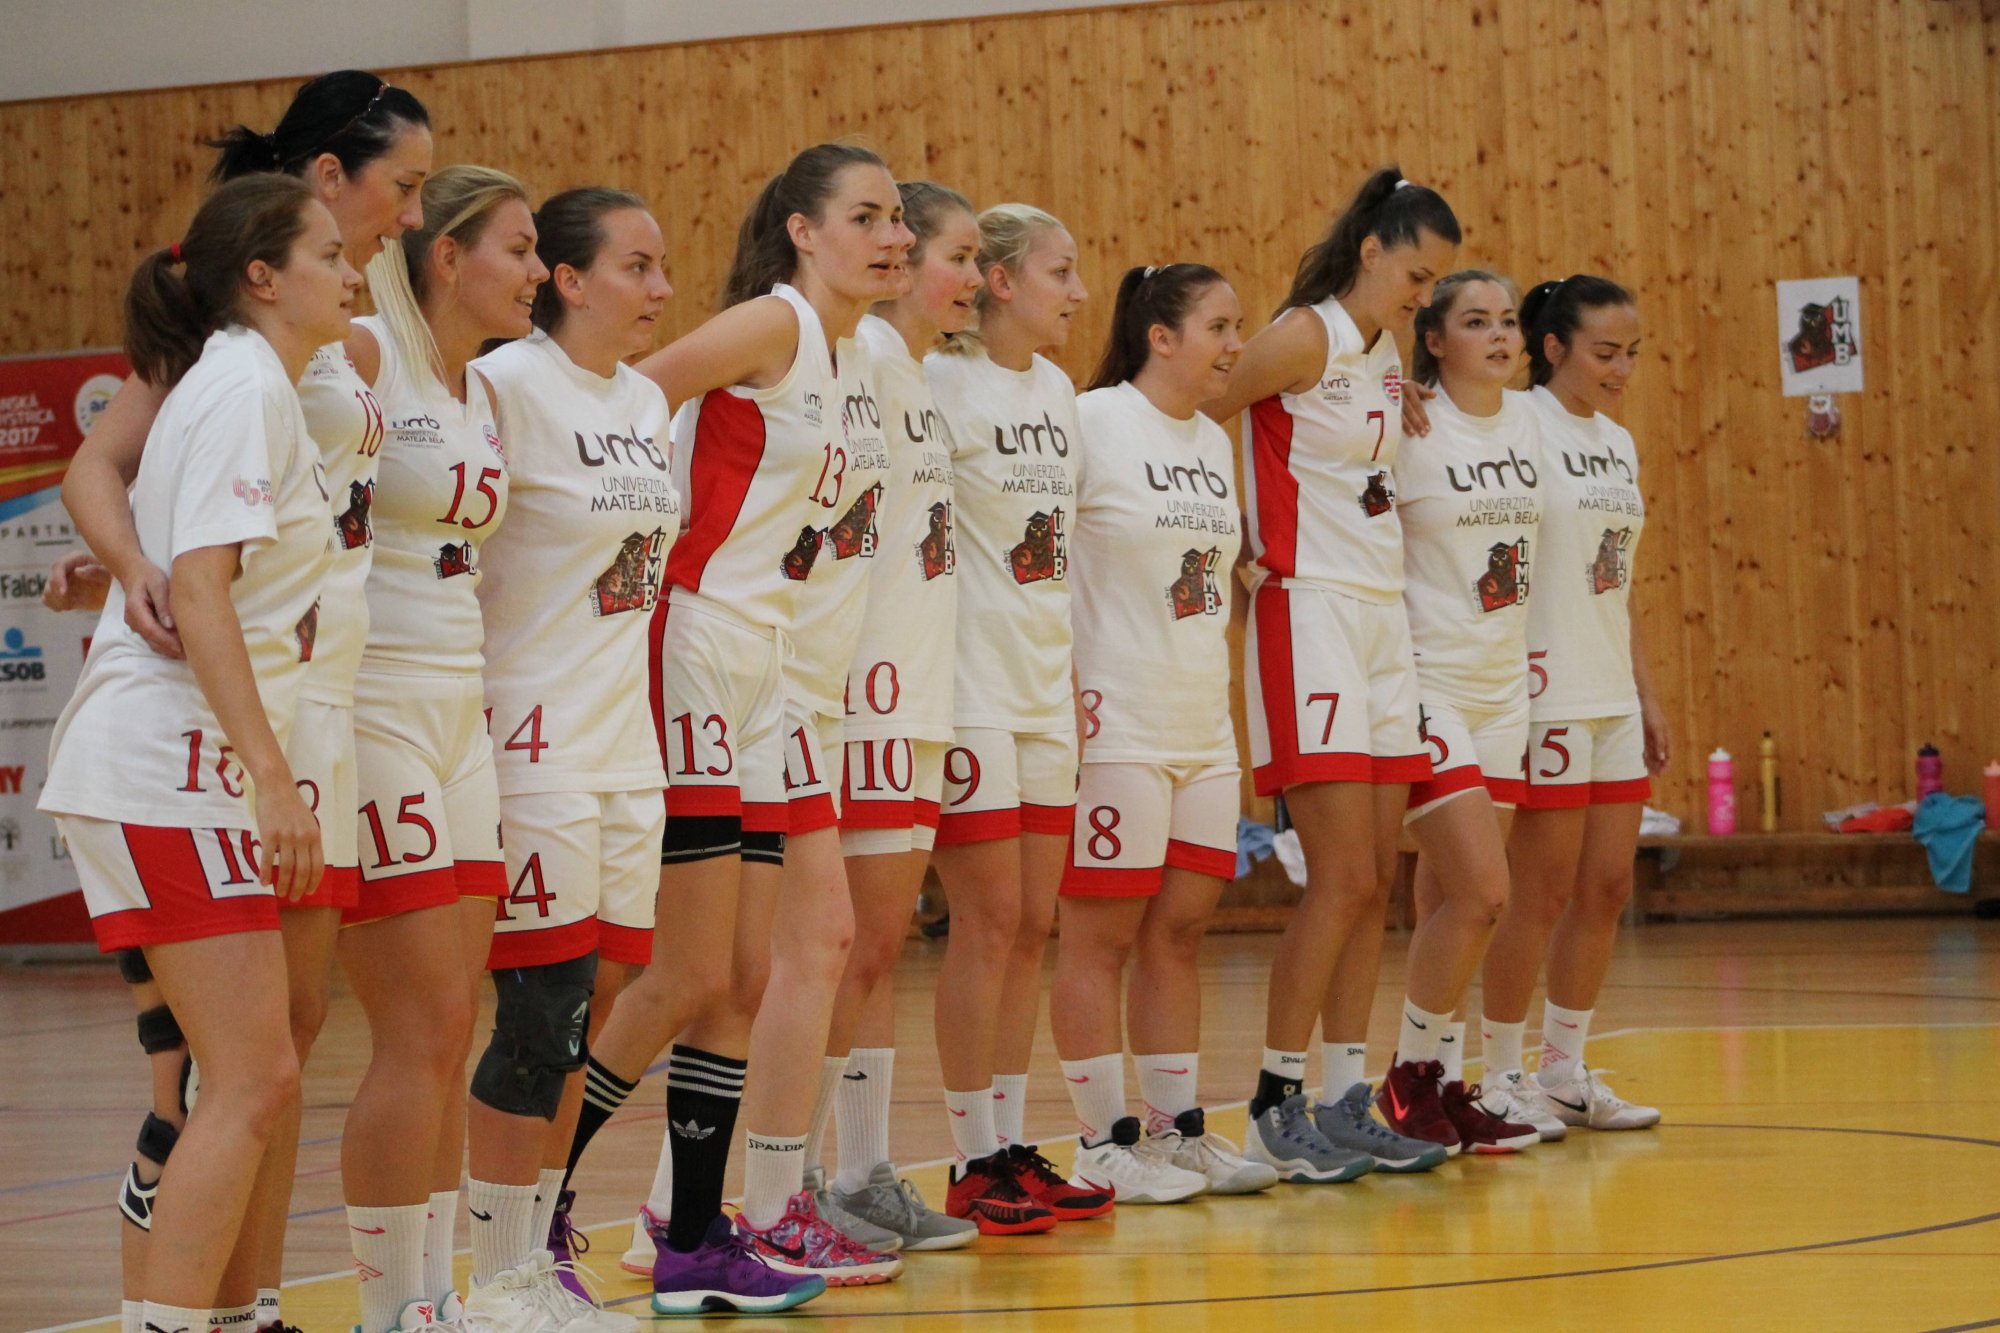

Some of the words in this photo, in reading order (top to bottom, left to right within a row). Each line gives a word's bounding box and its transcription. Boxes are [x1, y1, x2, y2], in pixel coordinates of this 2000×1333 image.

[1832, 301, 1851, 365] UMB
[845, 376, 880, 430] mb
[1321, 373, 1351, 389] umb
[0, 426, 40, 447] 2017
[355, 390, 384, 457] 18
[392, 413, 440, 430] umb
[994, 411, 1068, 458] umb
[1367, 411, 1384, 461] 7
[574, 424, 667, 471] umb
[851, 455, 874, 471] ATEJA
[1013, 463, 1067, 479] UNIVERZITA
[1446, 447, 1538, 492] umb
[1562, 446, 1634, 485] umb
[437, 461, 501, 529] 15
[602, 476, 669, 494] UNIVERZITA
[809, 442, 846, 508] 13
[1002, 480, 1048, 494] MATEJA
[1052, 481, 1073, 496] BELA
[1145, 456, 1228, 499] umb
[591, 493, 652, 512] MATEJA
[655, 497, 679, 514] BELA
[1155, 515, 1208, 532] MATEJA
[1212, 521, 1236, 536] BELA
[1166, 500, 1226, 518] UNIVERZITA
[1456, 512, 1509, 527] MATEJA
[1514, 511, 1540, 525] BELA
[1470, 497, 1534, 512] UNIVERZITA
[1578, 499, 1622, 514] MATEJA
[1051, 512, 1065, 581] UMB
[641, 532, 667, 612] UMB
[1202, 551, 1222, 615] UMB
[1515, 541, 1529, 605] UMB
[1306, 693, 1340, 745] 7
[672, 712, 733, 776] 13
[857, 738, 912, 792] 10
[1540, 727, 1570, 778] 5
[944, 747, 980, 806] 9
[358, 792, 437, 869] 15
[1088, 806, 1121, 860] 8
